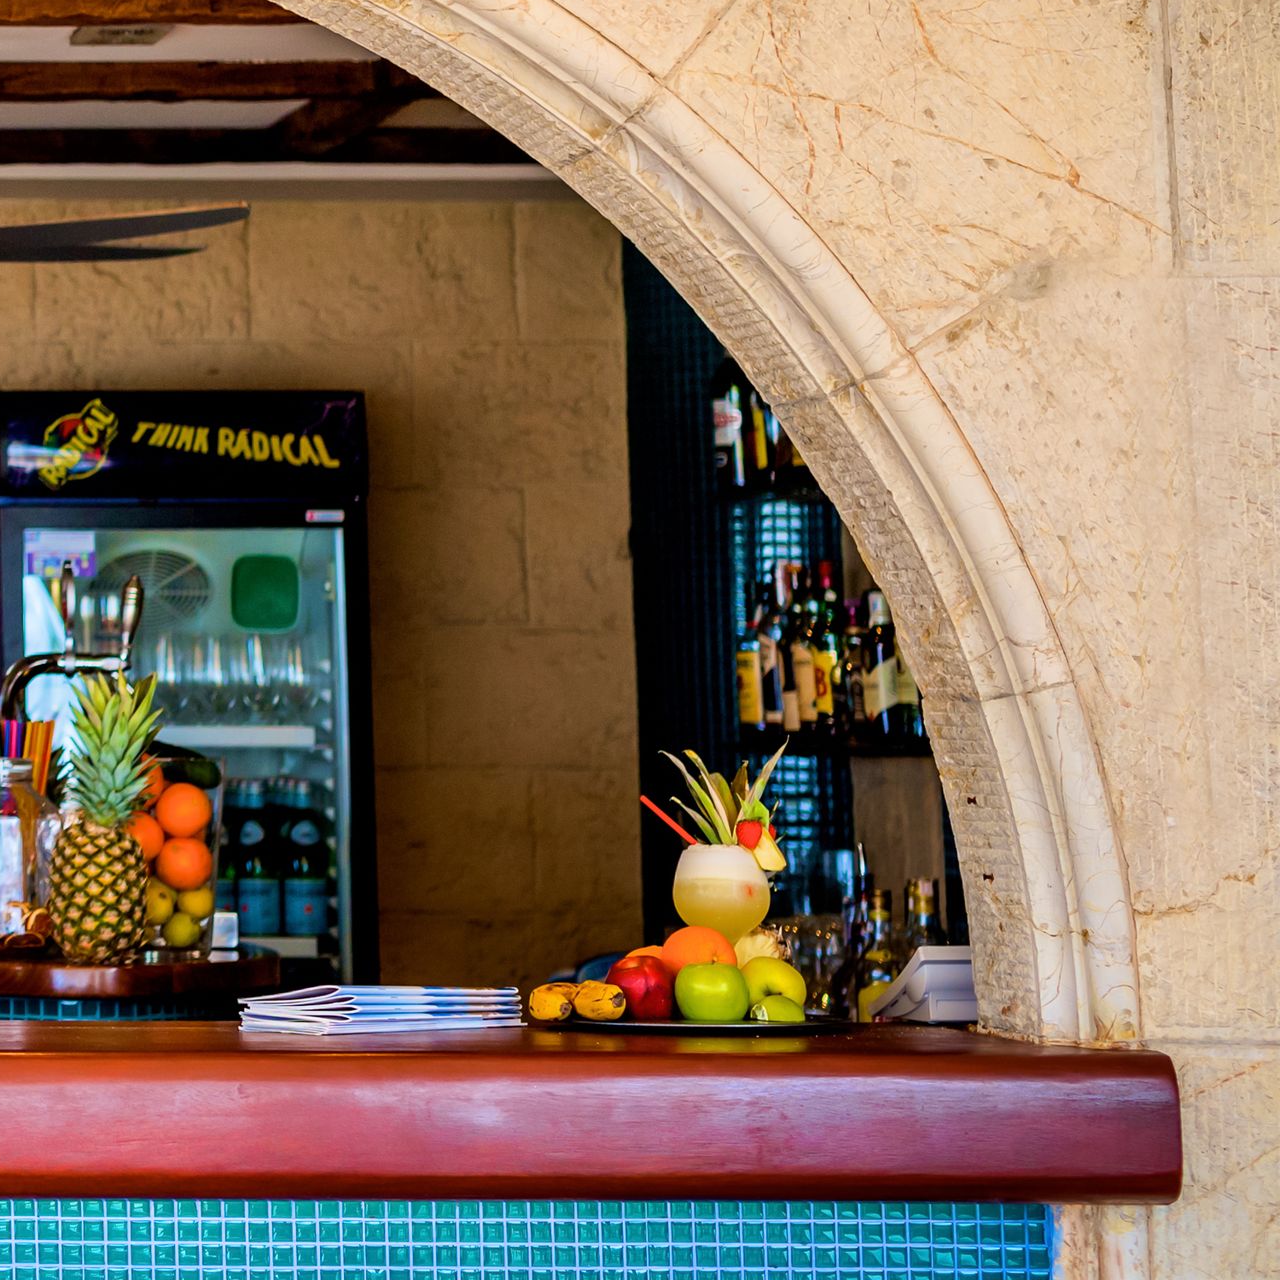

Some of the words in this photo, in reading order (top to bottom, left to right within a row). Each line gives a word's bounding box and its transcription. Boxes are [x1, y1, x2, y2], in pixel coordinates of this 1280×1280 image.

[38, 406, 116, 486] RADICAL
[131, 421, 209, 454] THINK
[217, 426, 340, 468] RADICAL
